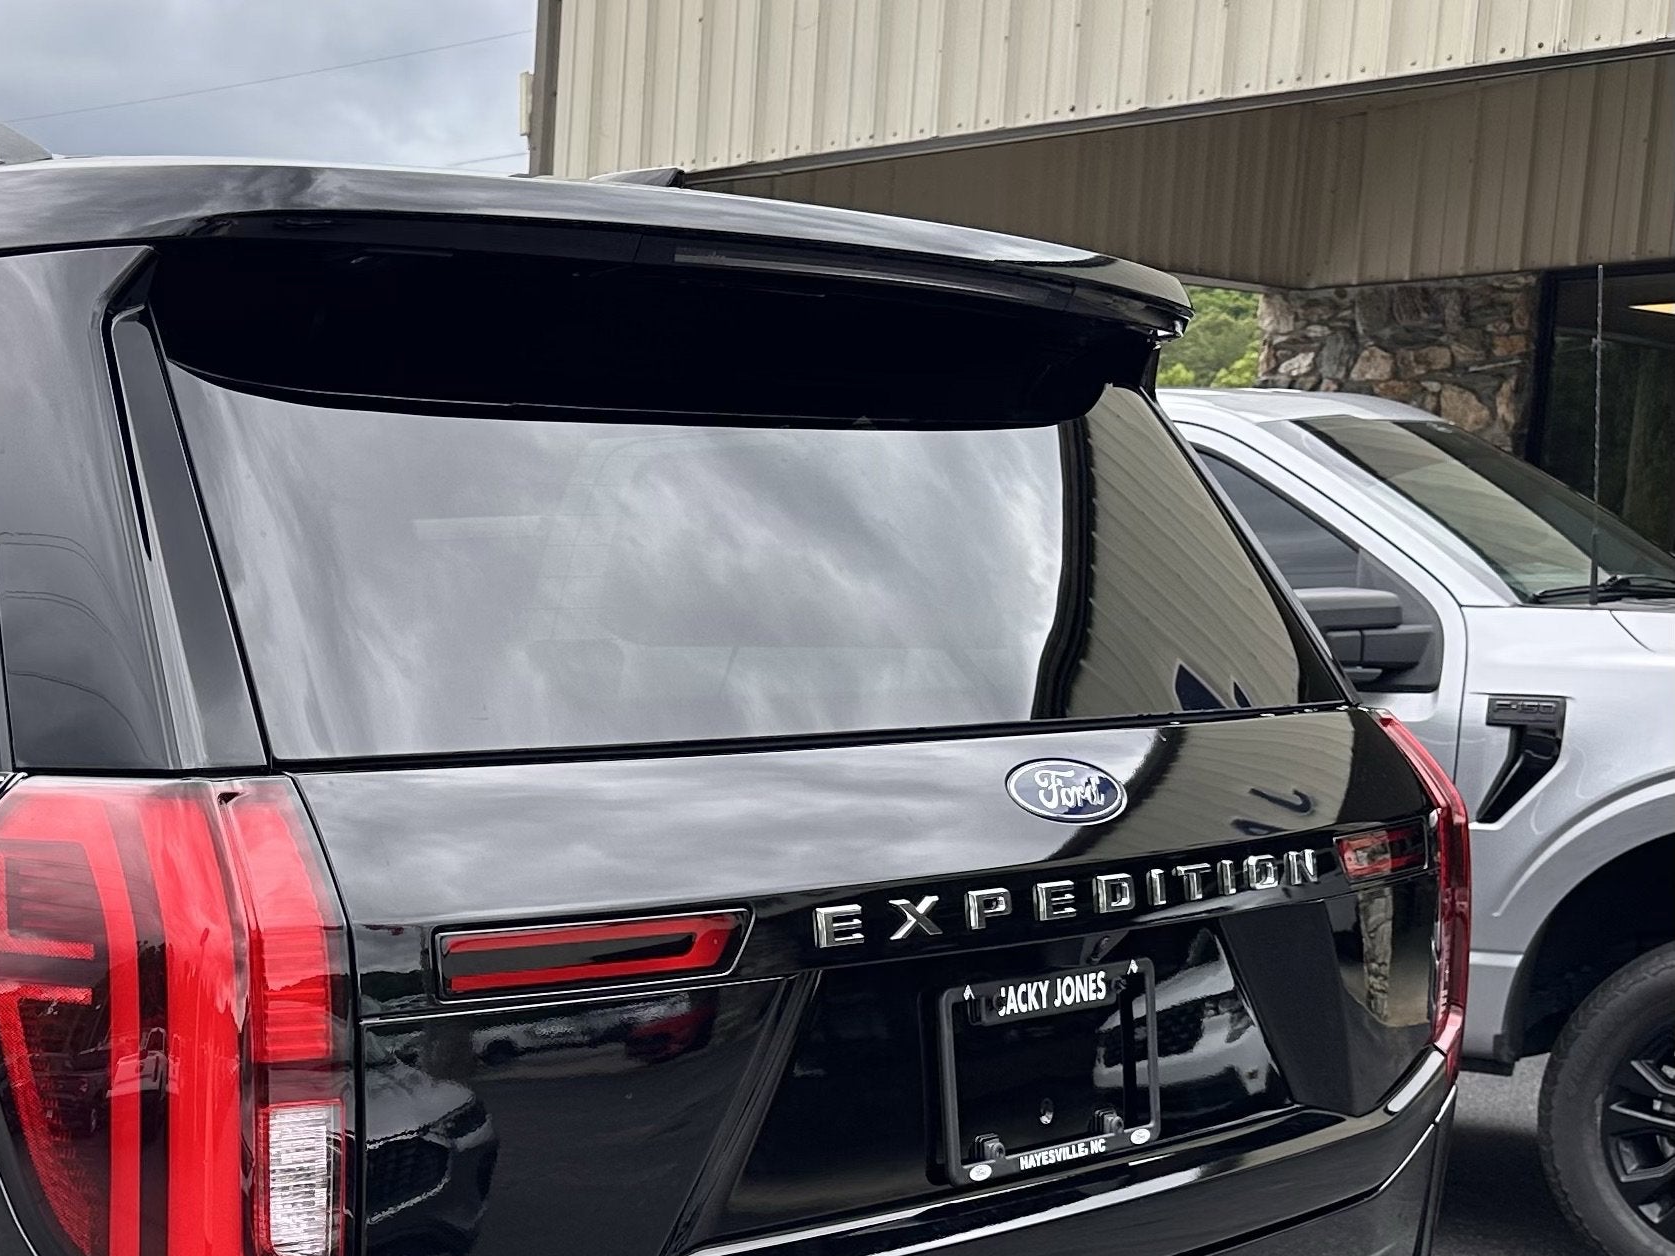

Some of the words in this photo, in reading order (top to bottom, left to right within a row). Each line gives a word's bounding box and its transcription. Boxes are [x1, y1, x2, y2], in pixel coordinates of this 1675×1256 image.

[1493, 700, 1557, 715] F-150
[1034, 769, 1105, 809] Ford
[814, 848, 1319, 949] EXPEDITION
[998, 979, 1050, 1017] JACKY
[1053, 970, 1107, 1008] JONES
[1019, 1142, 1089, 1171] HAYESVILLE,
[1090, 1138, 1107, 1155] NC
